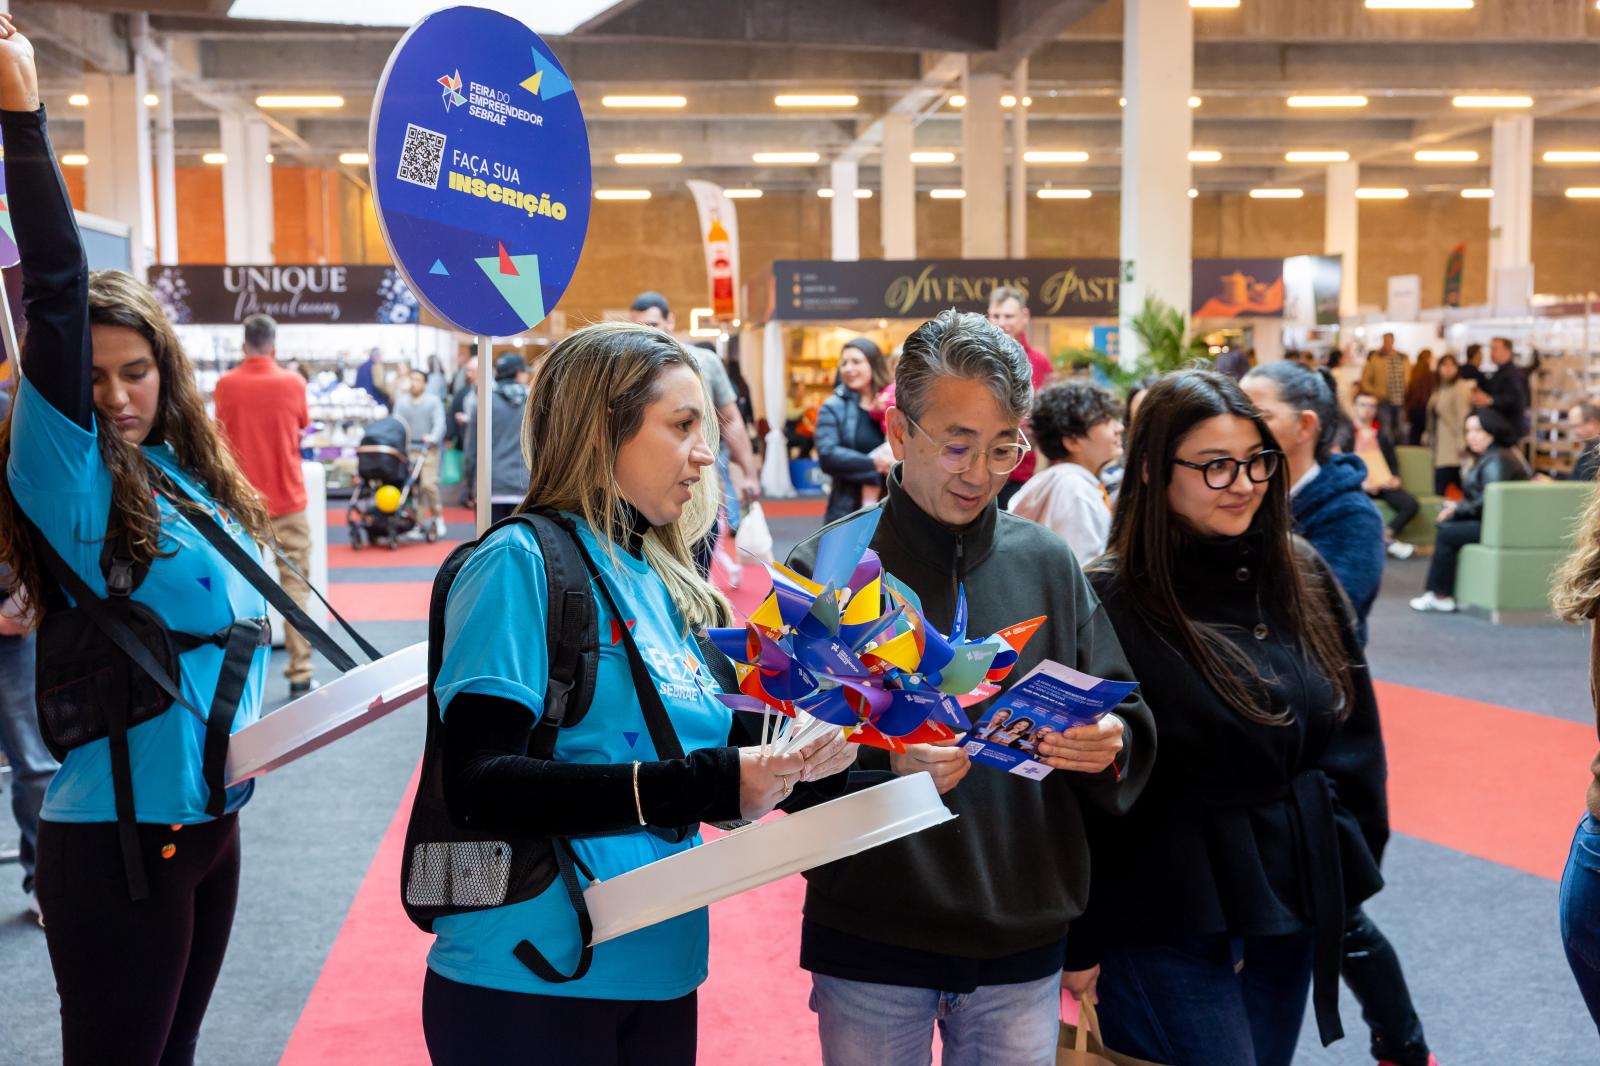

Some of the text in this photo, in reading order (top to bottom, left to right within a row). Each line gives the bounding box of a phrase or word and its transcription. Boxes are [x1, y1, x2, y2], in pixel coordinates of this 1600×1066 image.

[470, 81, 510, 104] FEIRA DO
[468, 105, 507, 126] SEBRAE
[469, 92, 543, 127] EMPREENDEDOR
[453, 149, 520, 185] FAÇA SUA
[448, 170, 567, 221] INSCRIÇÃO
[223, 266, 347, 293] UNIQUE
[659, 681, 699, 702] SEBRAE
